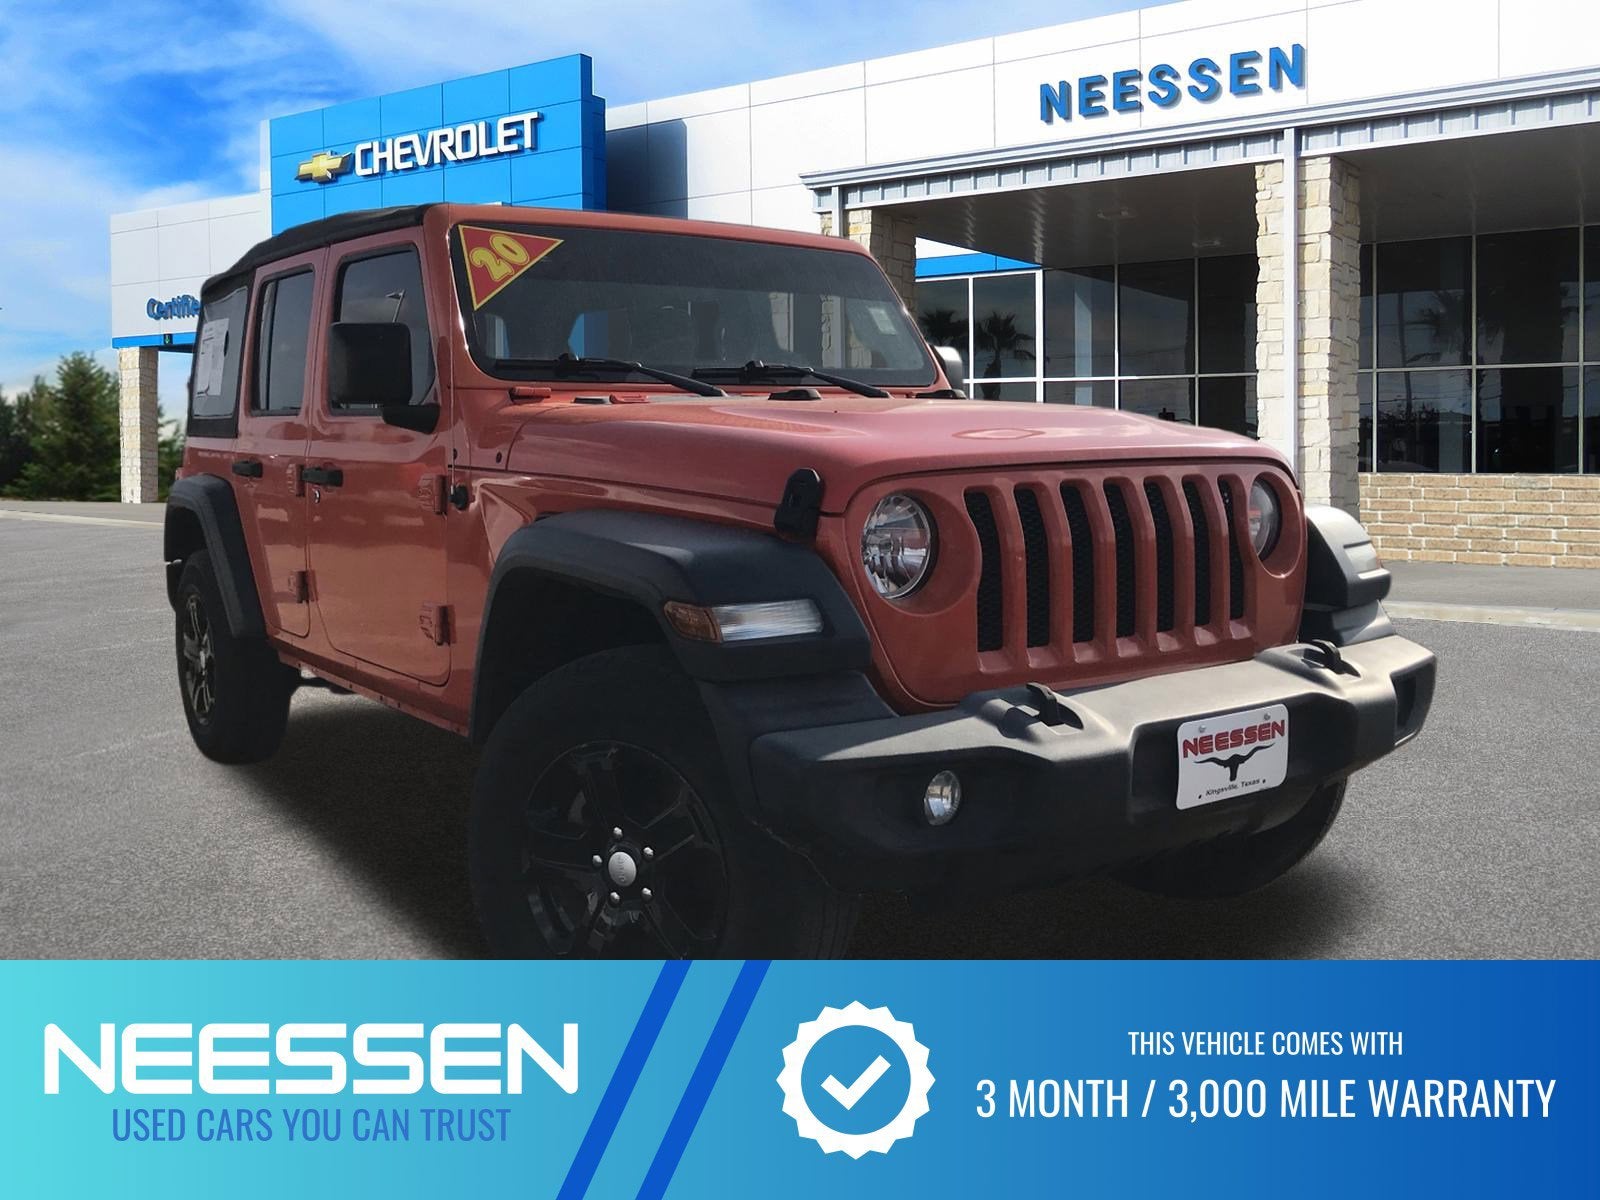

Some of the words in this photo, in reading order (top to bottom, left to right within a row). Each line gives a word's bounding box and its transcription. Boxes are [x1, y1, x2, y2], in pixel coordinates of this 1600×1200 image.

[1040, 43, 1306, 123] NEESSEN
[354, 111, 542, 178] CHEVROLET
[470, 232, 530, 282] 20
[1183, 719, 1285, 758] NEESSEN
[1241, 778, 1260, 788] Texas
